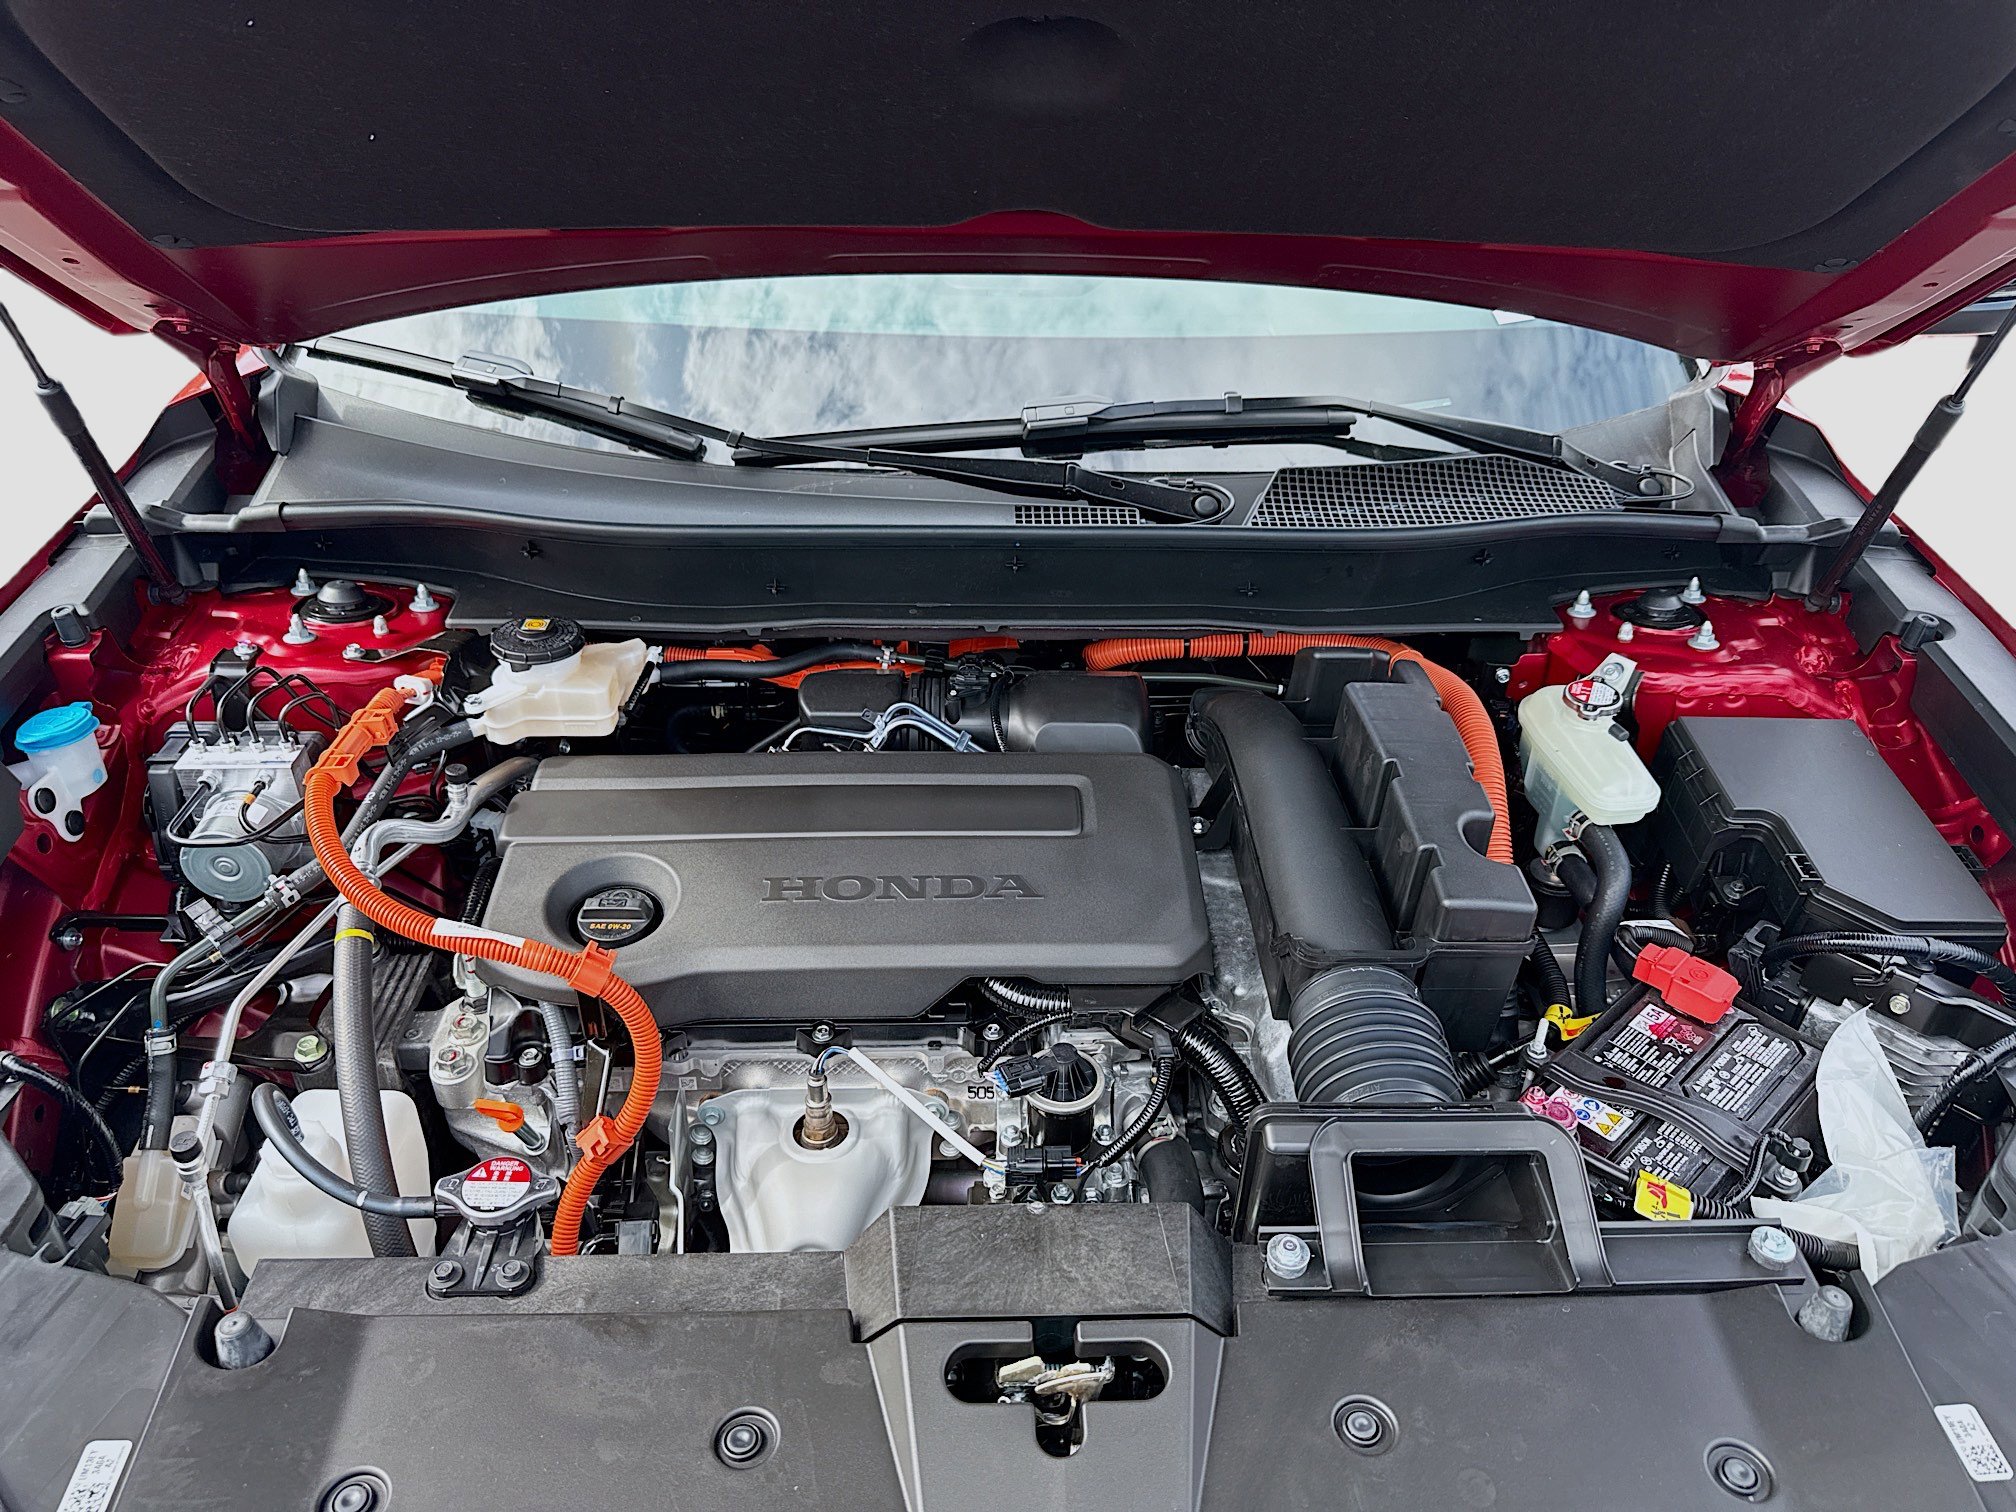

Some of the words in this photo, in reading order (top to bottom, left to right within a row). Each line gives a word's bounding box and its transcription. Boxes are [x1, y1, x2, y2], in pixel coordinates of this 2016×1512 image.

[760, 874, 1044, 902] HONDA
[1647, 1008, 1664, 1021] 5A
[967, 1085, 995, 1100] 505
